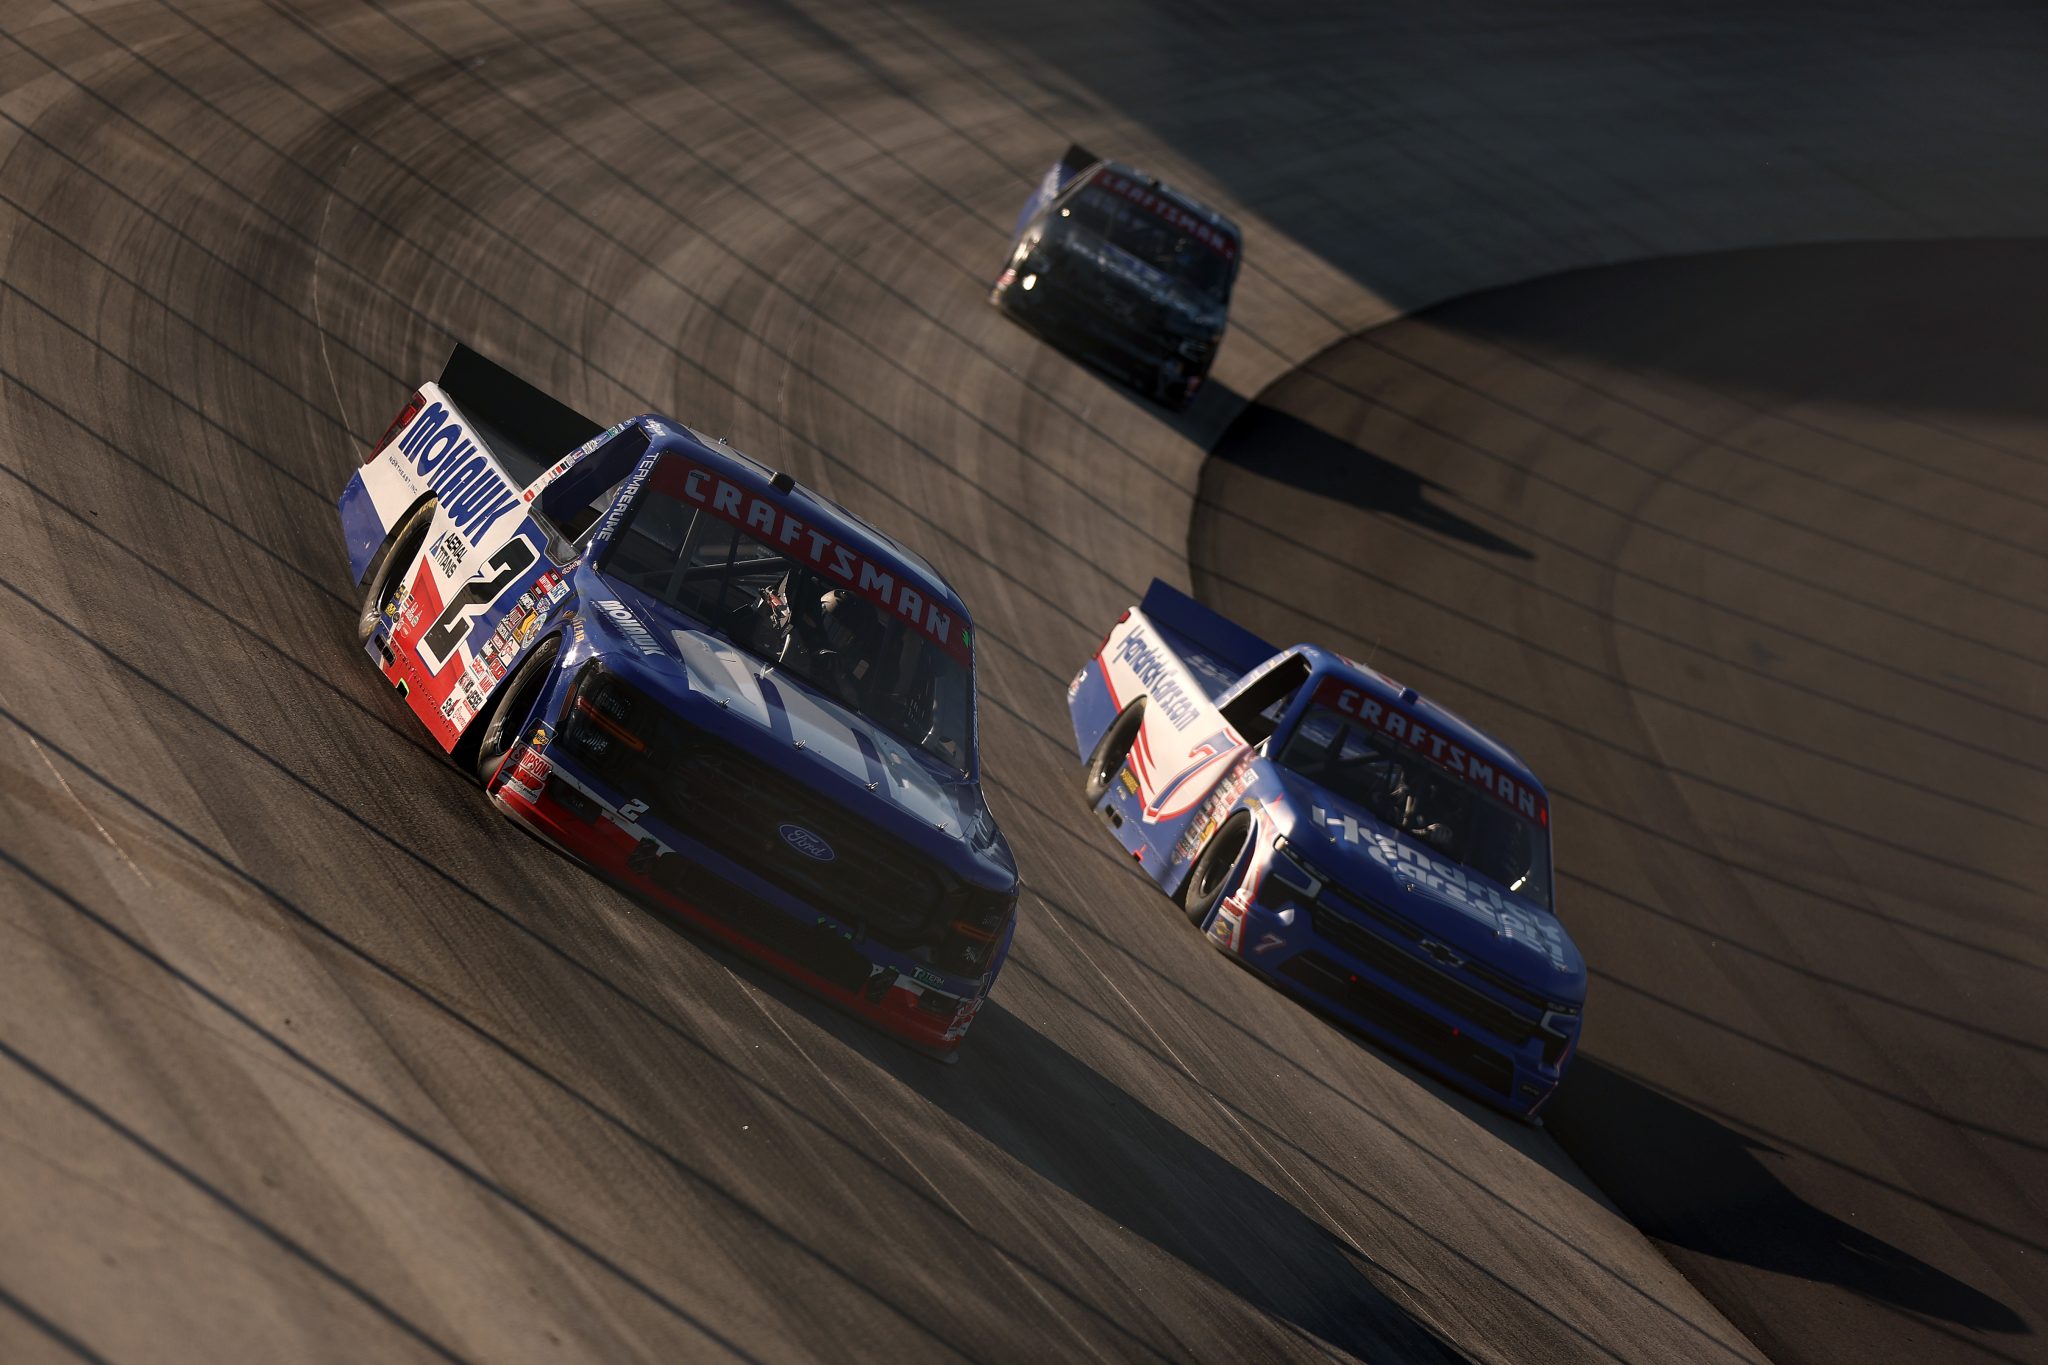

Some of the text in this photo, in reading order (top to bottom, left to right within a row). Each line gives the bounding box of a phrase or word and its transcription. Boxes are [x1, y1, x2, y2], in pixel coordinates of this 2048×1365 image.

[398, 401, 521, 548] MOHAWK
[435, 545, 457, 578] TITANS
[444, 532, 468, 564] AERIAL
[684, 469, 950, 644] CRAFTSMAN
[420, 534, 538, 670] 2
[597, 600, 666, 656] MOHAWK
[514, 746, 551, 778] SIMPSON
[1143, 727, 1244, 823] 7
[1337, 687, 1536, 819] CRAFTSMAN
[617, 799, 649, 824] 2
[785, 827, 831, 859] Ford
